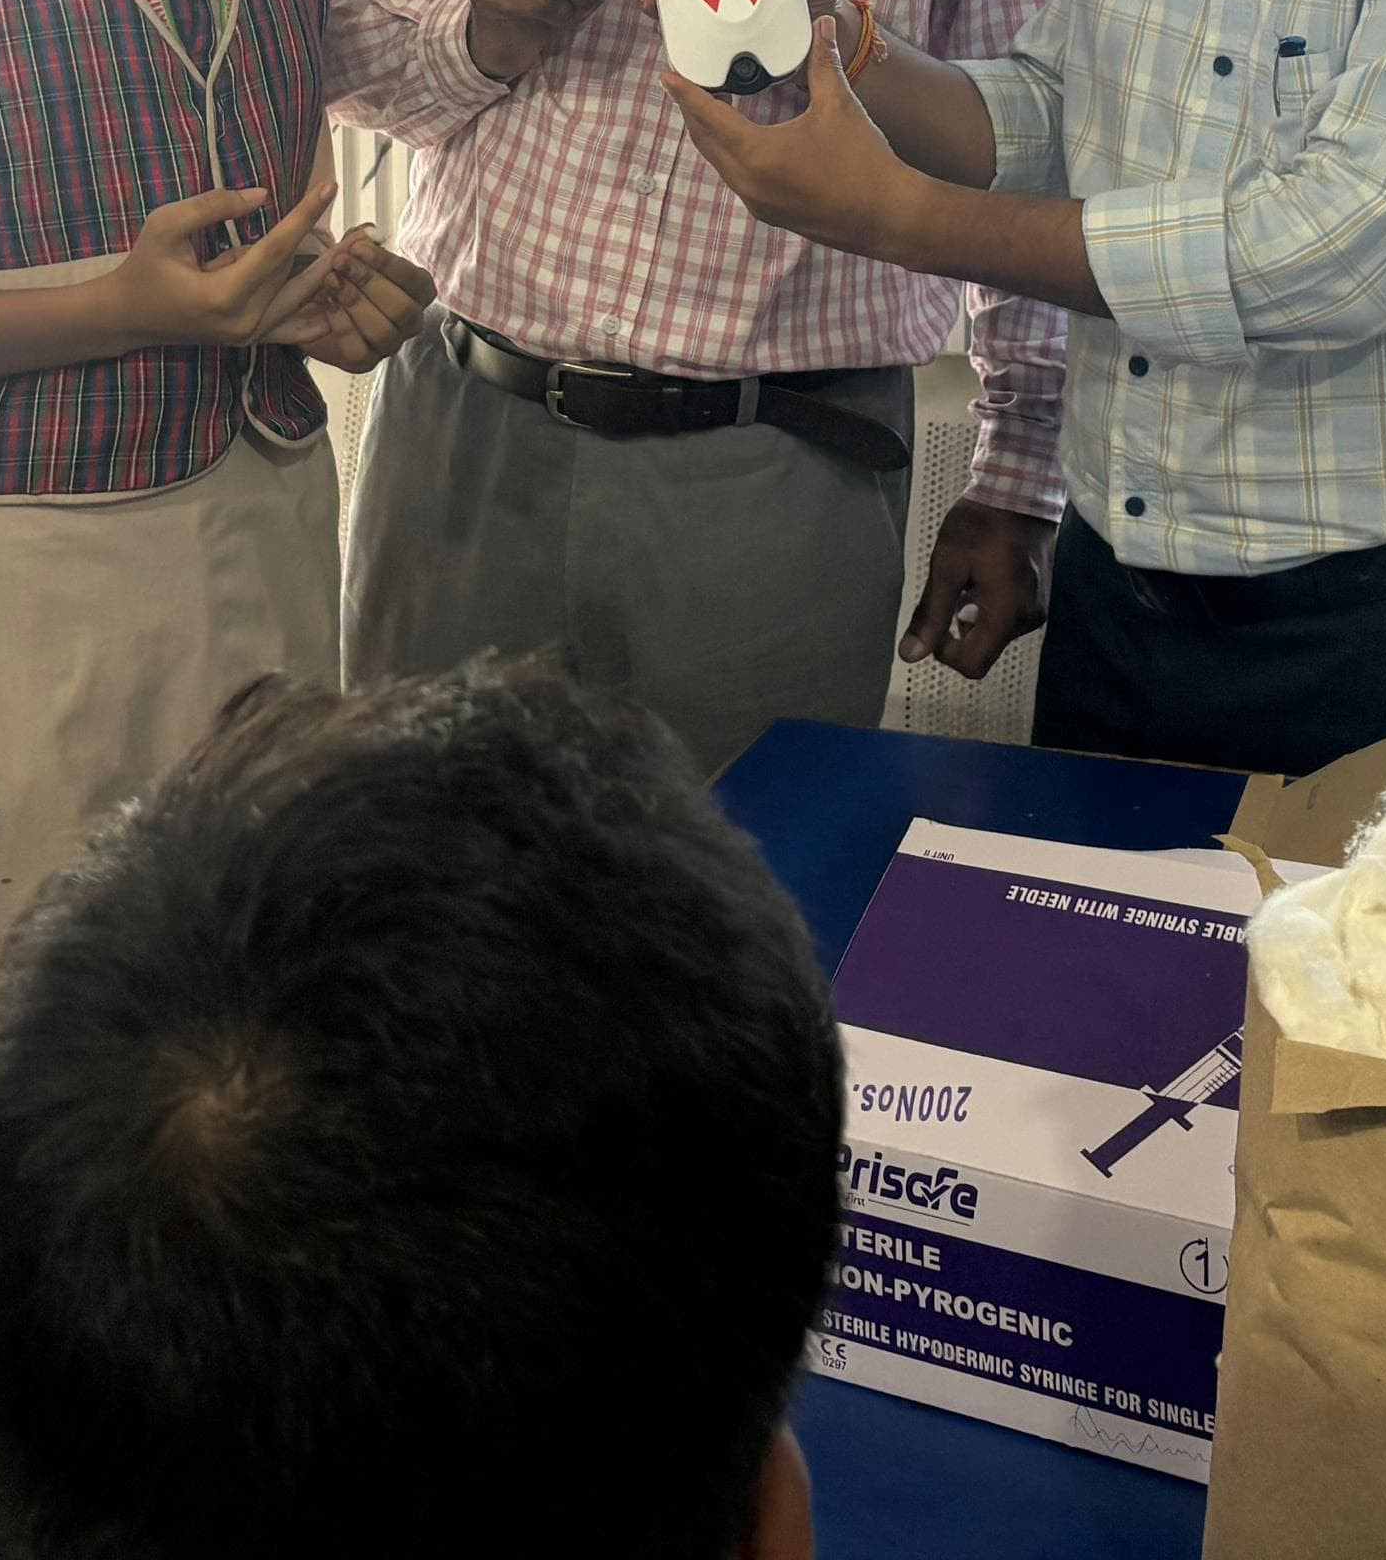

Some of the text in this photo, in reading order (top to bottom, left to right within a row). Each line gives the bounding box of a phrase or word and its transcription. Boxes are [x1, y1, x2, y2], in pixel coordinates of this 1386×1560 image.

[1006, 884, 1071, 912] NEEDLE
[1073, 898, 1120, 921] WITH
[1122, 907, 1201, 935] SYRINGE
[840, 1223, 942, 1272] TERILE
[822, 1308, 1216, 1433] STERILE HYPODERMIC SYRINGE FOR SINGLE
